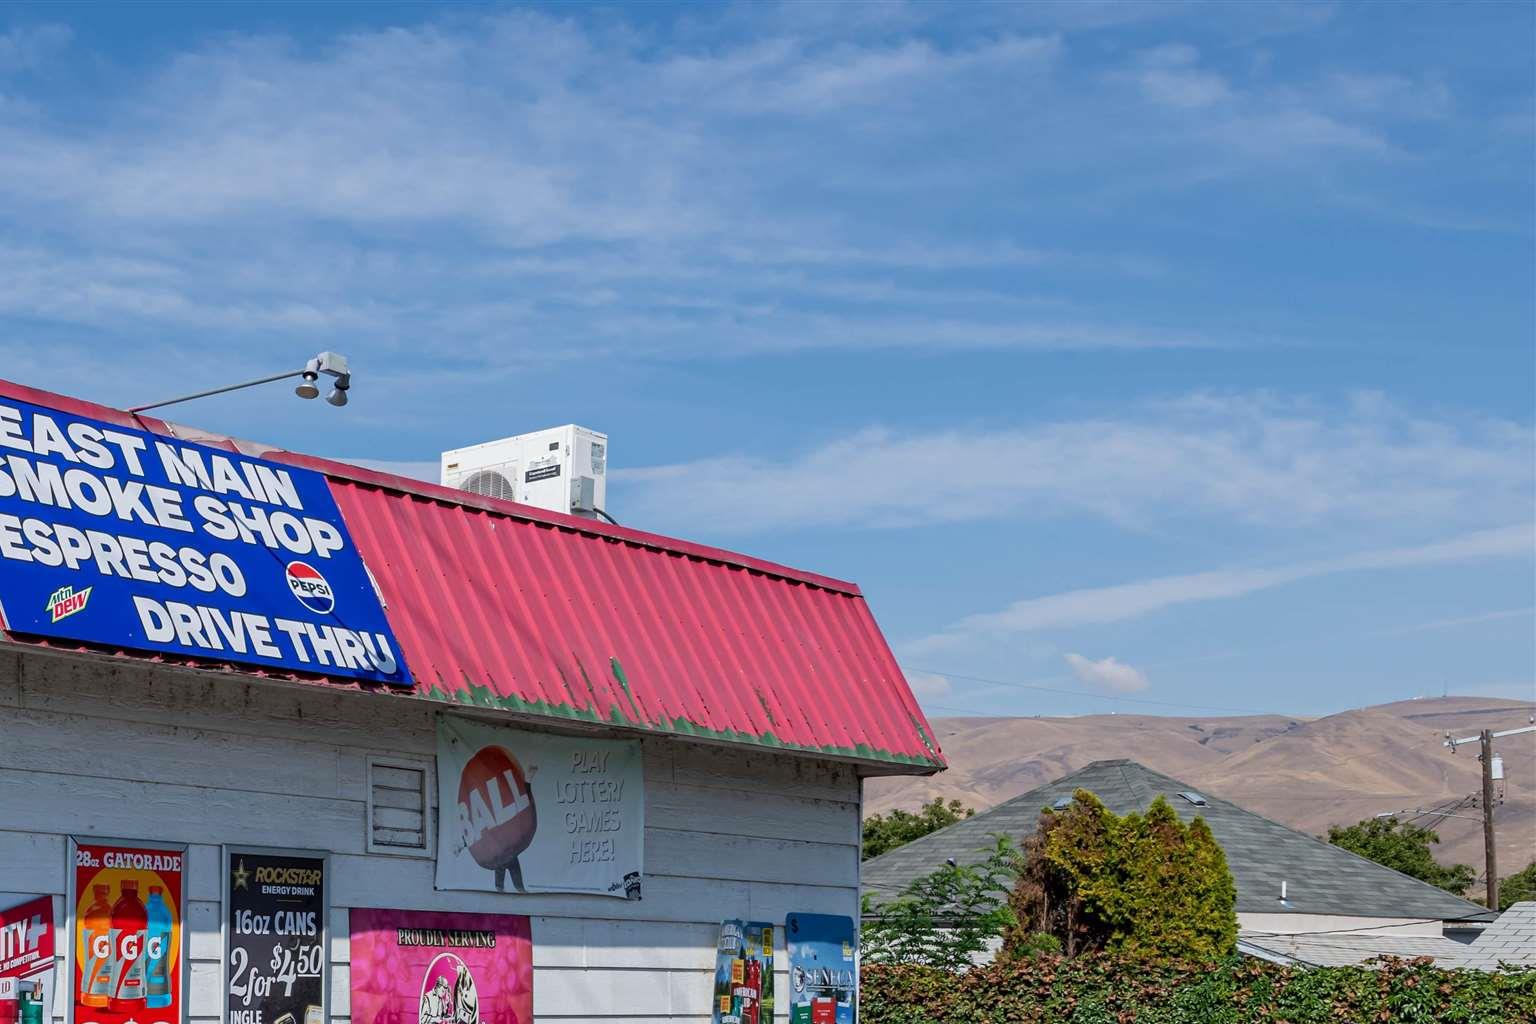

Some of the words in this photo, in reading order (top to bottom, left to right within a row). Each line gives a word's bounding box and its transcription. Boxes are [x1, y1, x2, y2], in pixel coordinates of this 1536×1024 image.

[157, 442, 303, 510] MAIN
[194, 496, 343, 559] SHOP
[291, 579, 330, 597] PEPSI
[133, 595, 282, 660] DRIVE
[276, 618, 397, 675] THRU
[571, 751, 610, 774] PLAY
[555, 779, 625, 804] LOTTERY
[564, 808, 621, 834] GAMES
[104, 852, 181, 872] GATORADE
[569, 839, 615, 864] HERE!
[255, 867, 322, 885] ROCKSTAR
[262, 885, 291, 896] ENERGY
[291, 886, 315, 896] DRINK
[274, 910, 316, 937] CANS
[93, 935, 109, 958] G
[121, 935, 138, 960] G
[147, 937, 161, 959] G
[397, 929, 446, 946] PROUDLY
[448, 930, 496, 948] SERVING
[230, 947, 249, 997] 2
[243, 967, 276, 1006] for
[805, 968, 853, 986] SENECA
